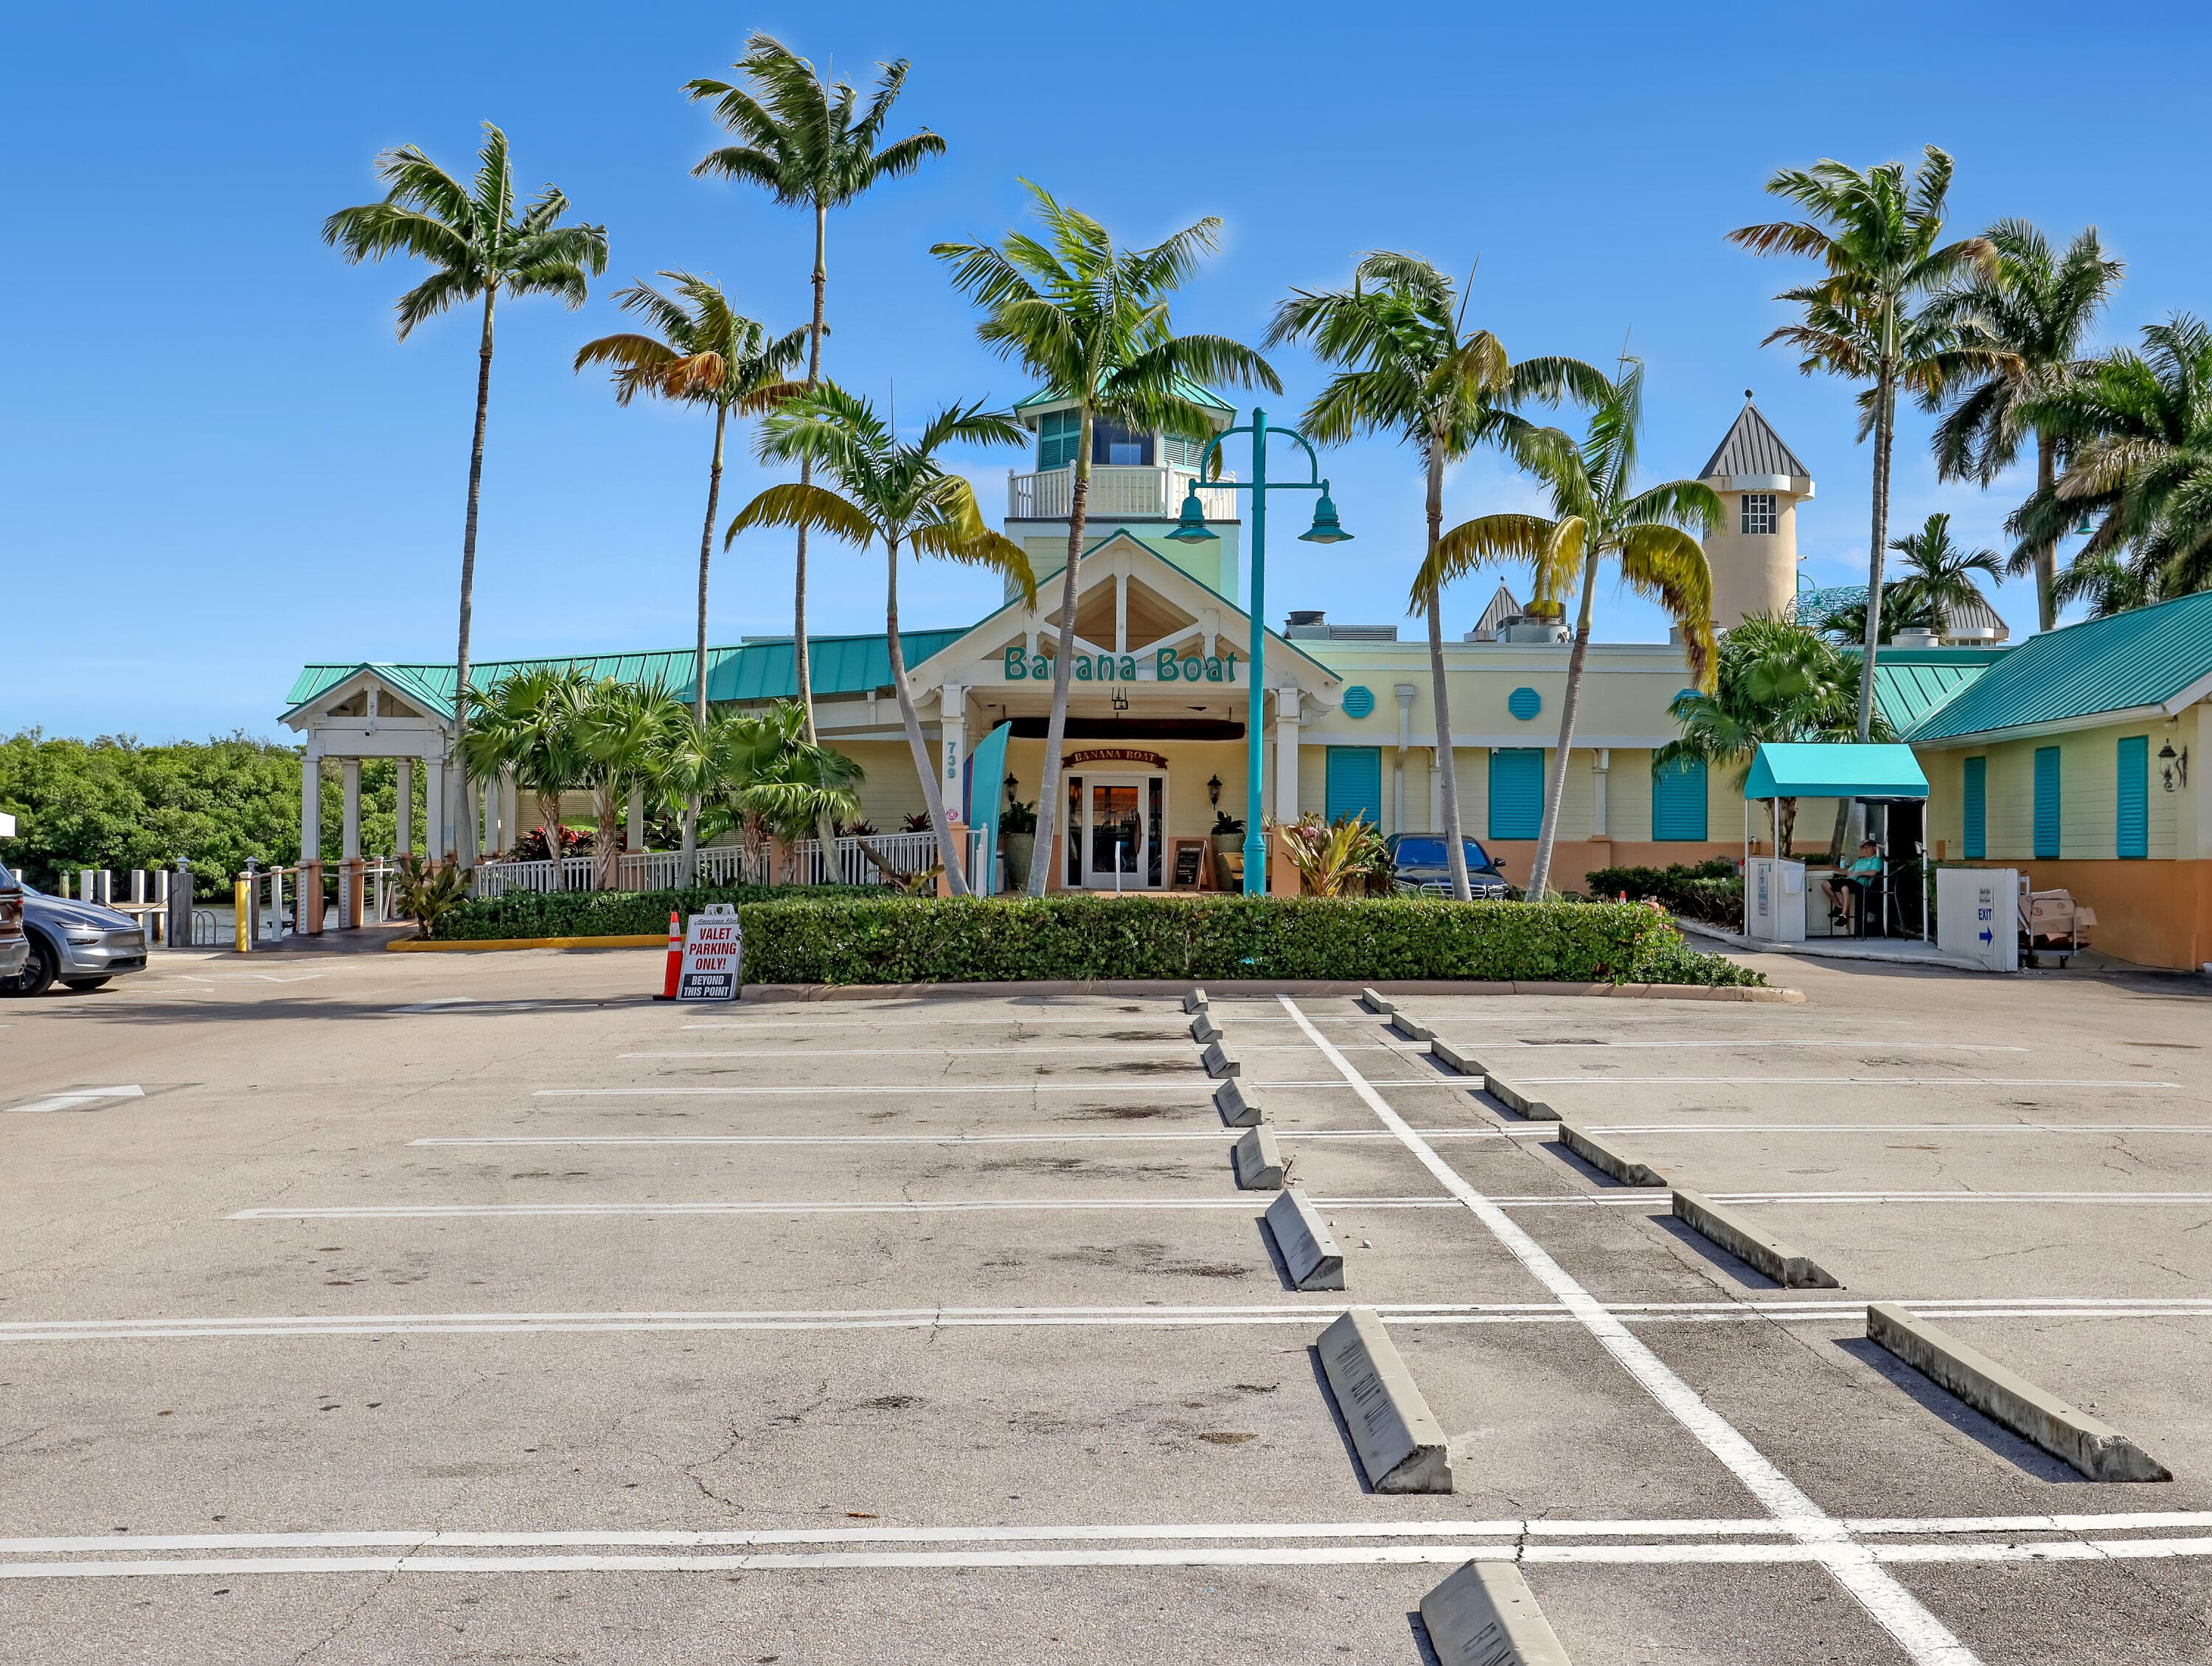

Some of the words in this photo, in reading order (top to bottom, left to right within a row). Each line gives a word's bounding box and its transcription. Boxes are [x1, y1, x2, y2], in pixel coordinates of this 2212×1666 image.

[1156, 648, 1237, 682] Boat
[947, 742, 956, 778] 739
[1075, 750, 1121, 761] BANANA
[1126, 750, 1156, 761] BOAT
[1978, 908, 1992, 920] EXIT
[700, 928, 731, 940] VALET
[689, 943, 737, 955] PARKING
[695, 958, 726, 970] ONLY!
[692, 975, 724, 985] BEYOND
[684, 987, 702, 997] THIS
[703, 986, 729, 996] POINT
